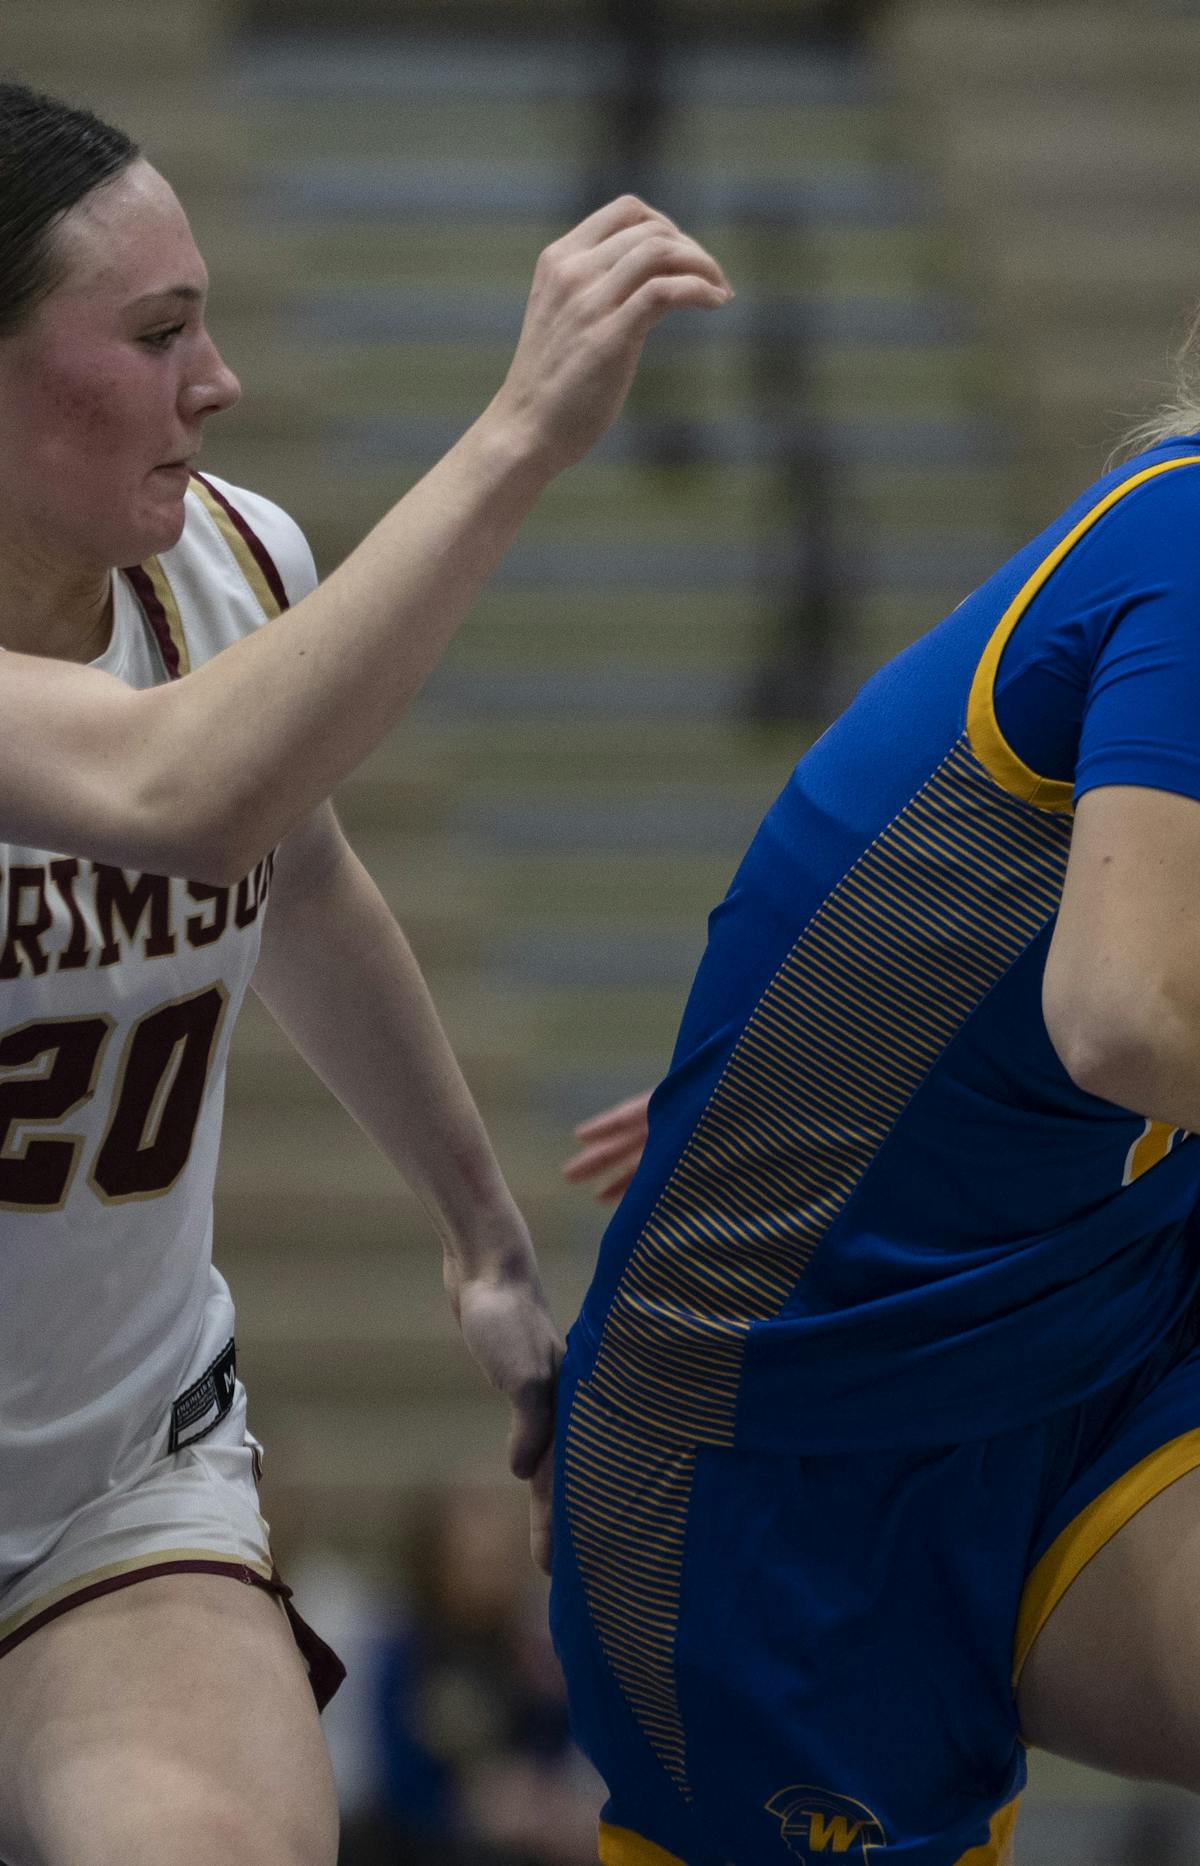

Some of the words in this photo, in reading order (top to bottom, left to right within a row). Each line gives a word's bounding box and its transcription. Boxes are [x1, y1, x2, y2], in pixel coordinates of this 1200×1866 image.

[0, 851, 276, 979] RIMSO
[0, 978, 231, 1213] 20
[802, 1811, 861, 1852] W
